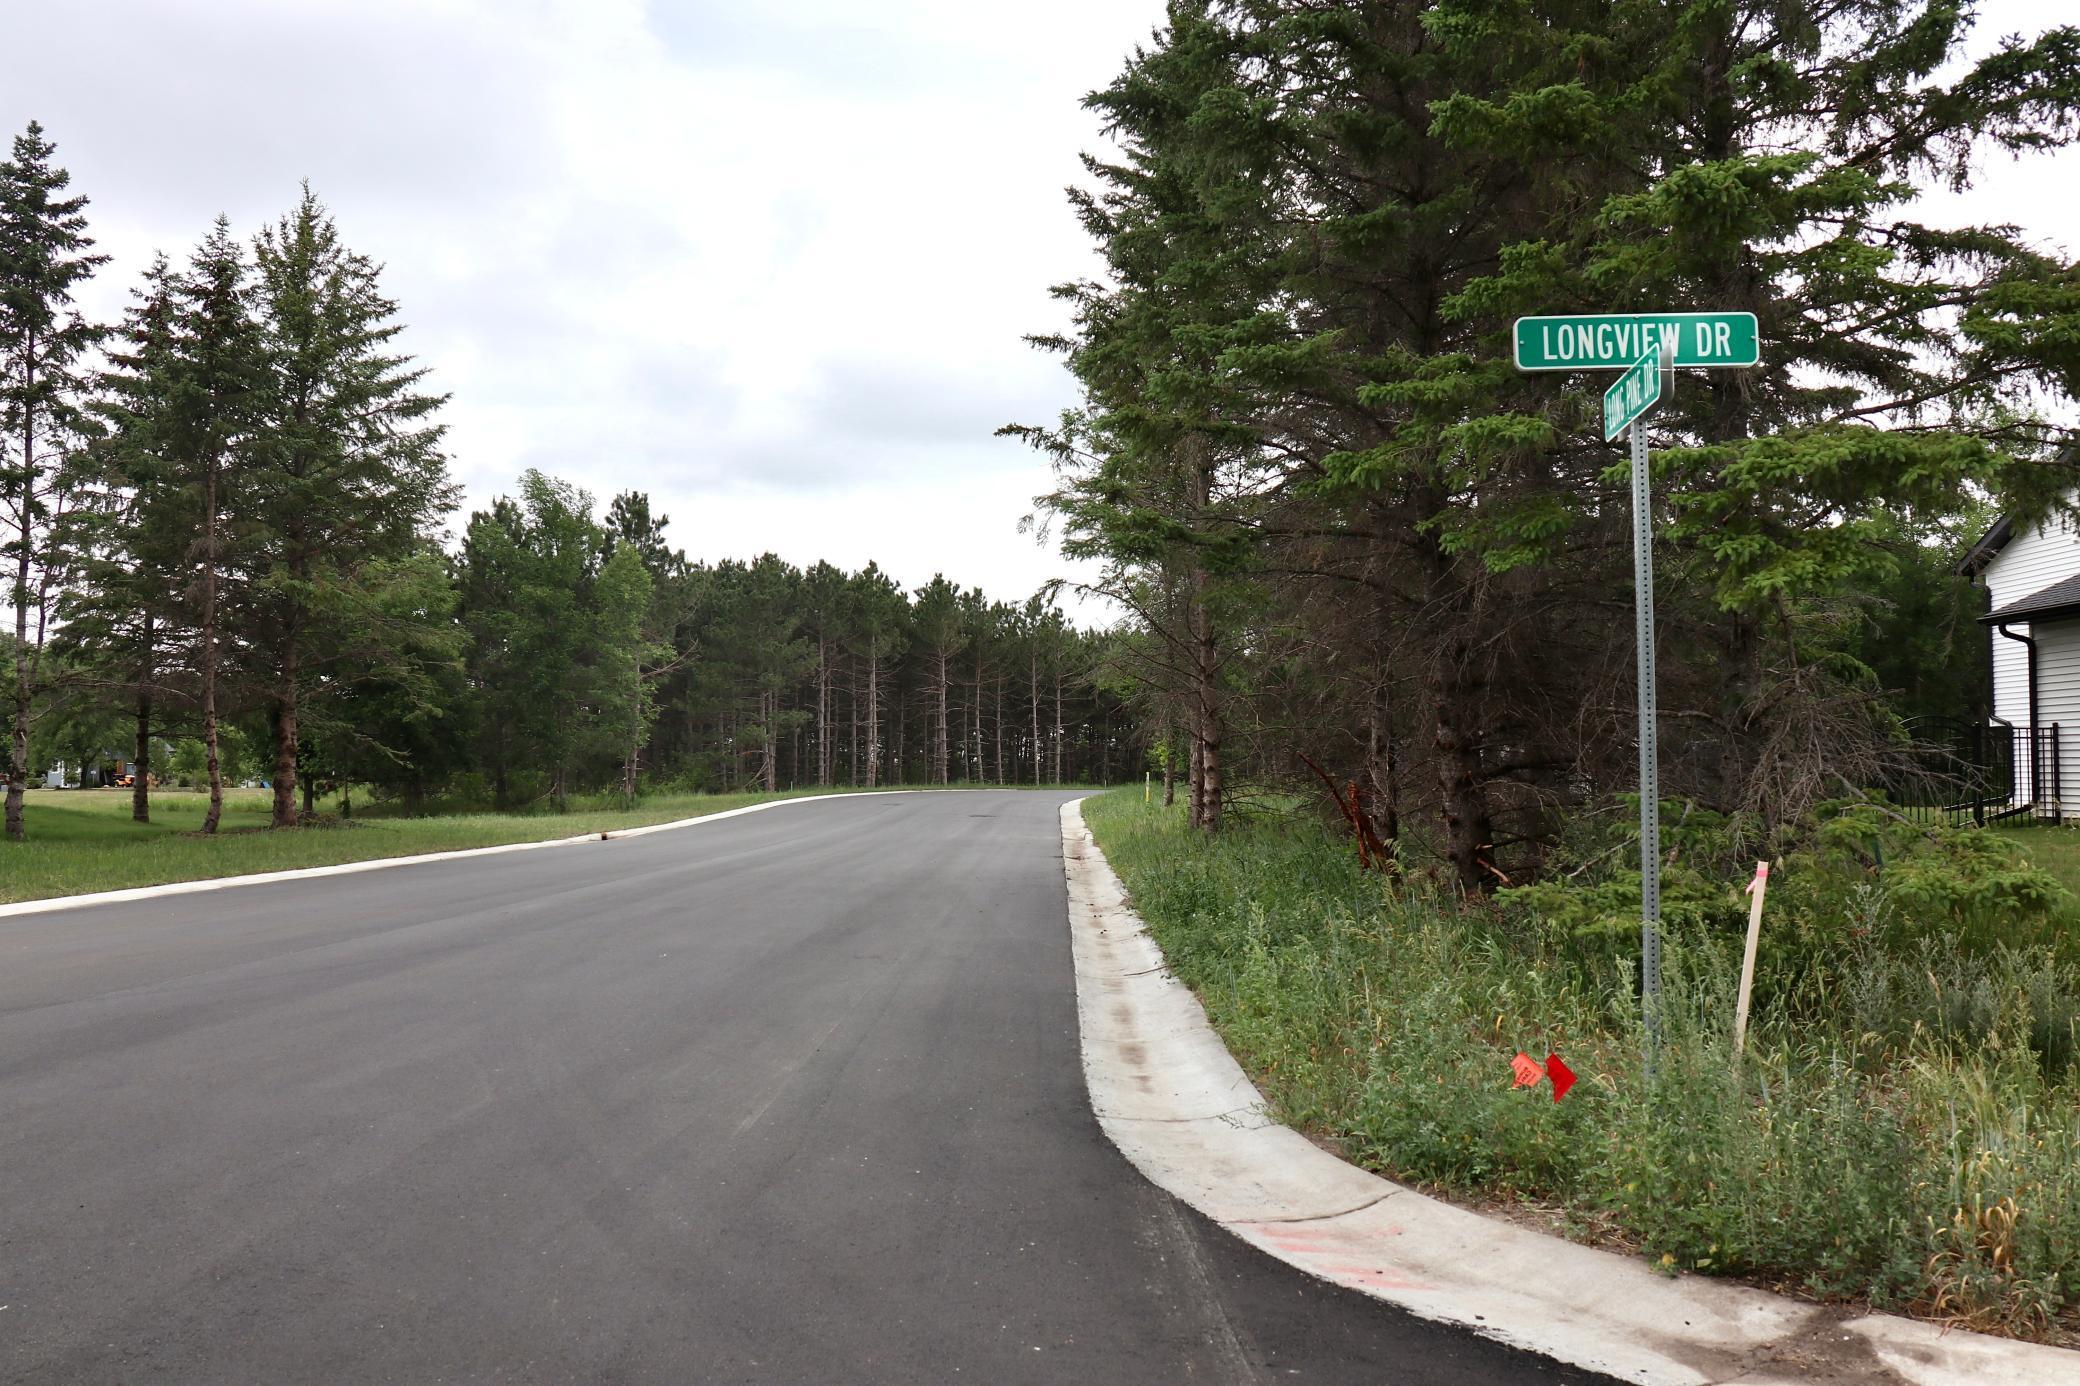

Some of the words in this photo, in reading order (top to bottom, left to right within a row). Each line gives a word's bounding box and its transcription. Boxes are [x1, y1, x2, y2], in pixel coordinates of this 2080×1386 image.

[1543, 323, 1680, 360] LONGVIEW
[1696, 322, 1731, 357] DR
[1608, 386, 1624, 430] LONG
[1626, 370, 1642, 414] PINE
[1644, 358, 1655, 399] DR
